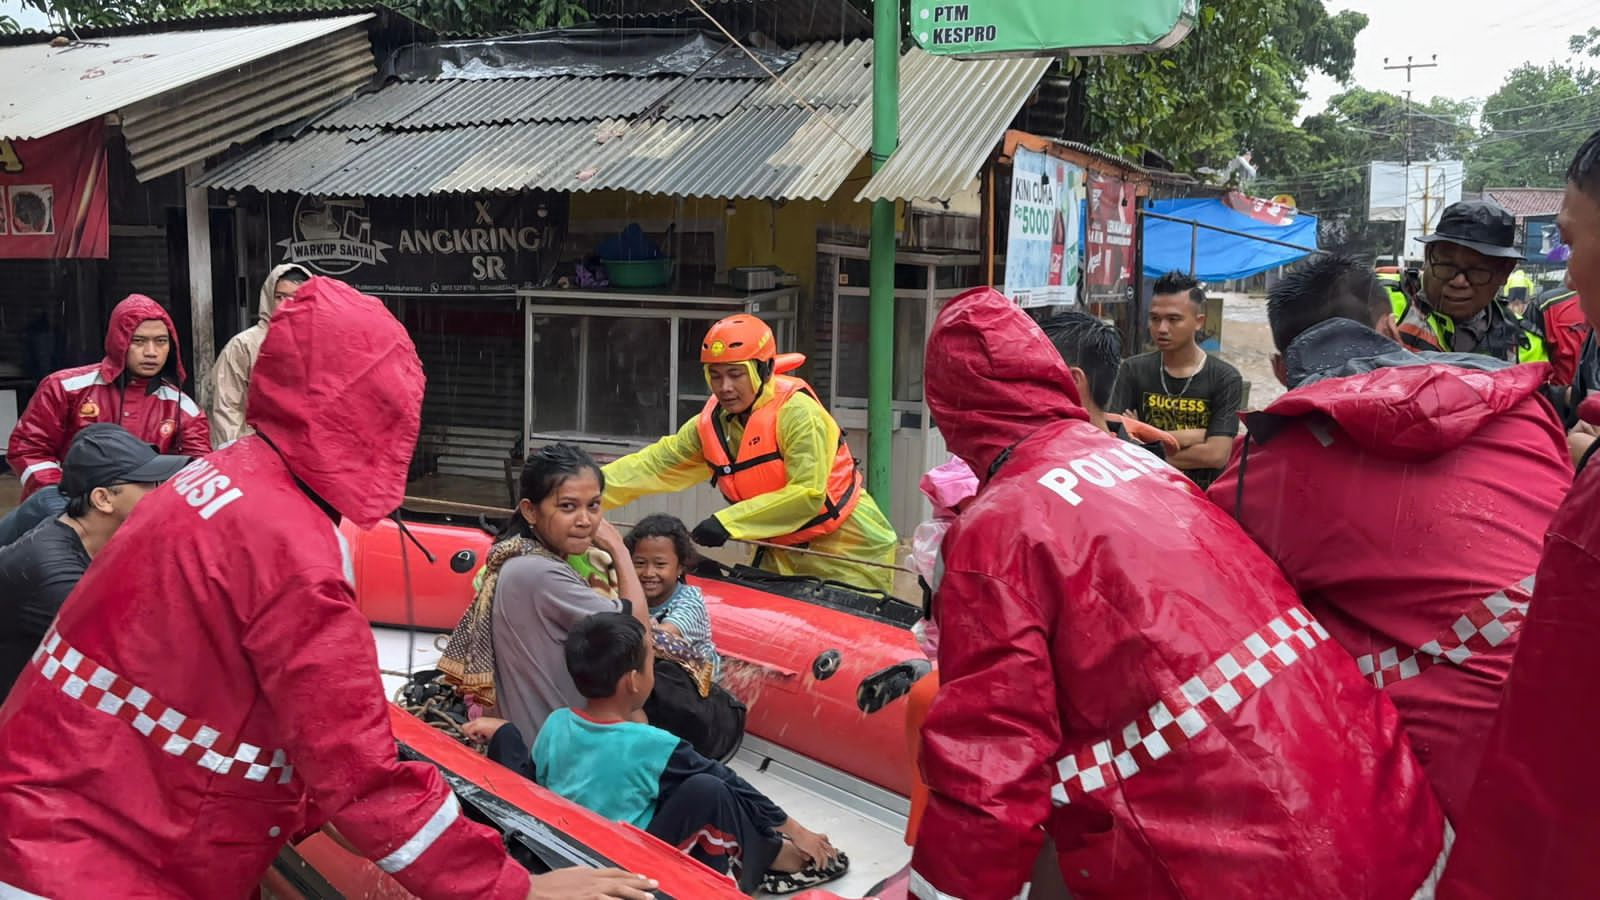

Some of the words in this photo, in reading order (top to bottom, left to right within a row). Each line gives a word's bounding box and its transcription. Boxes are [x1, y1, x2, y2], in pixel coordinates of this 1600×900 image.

[935, 5, 969, 22] PTM
[933, 25, 996, 44] KESPRO
[1015, 178, 1031, 202] KINI
[1032, 181, 1054, 206] CUMA
[474, 200, 494, 224] X
[1022, 206, 1050, 236] 5000
[294, 243, 336, 257] WARKOP
[340, 244, 372, 259] SANTAI
[472, 255, 506, 280] SR
[1148, 394, 1205, 412] SUCCESS
[1038, 443, 1167, 506] POLIS
